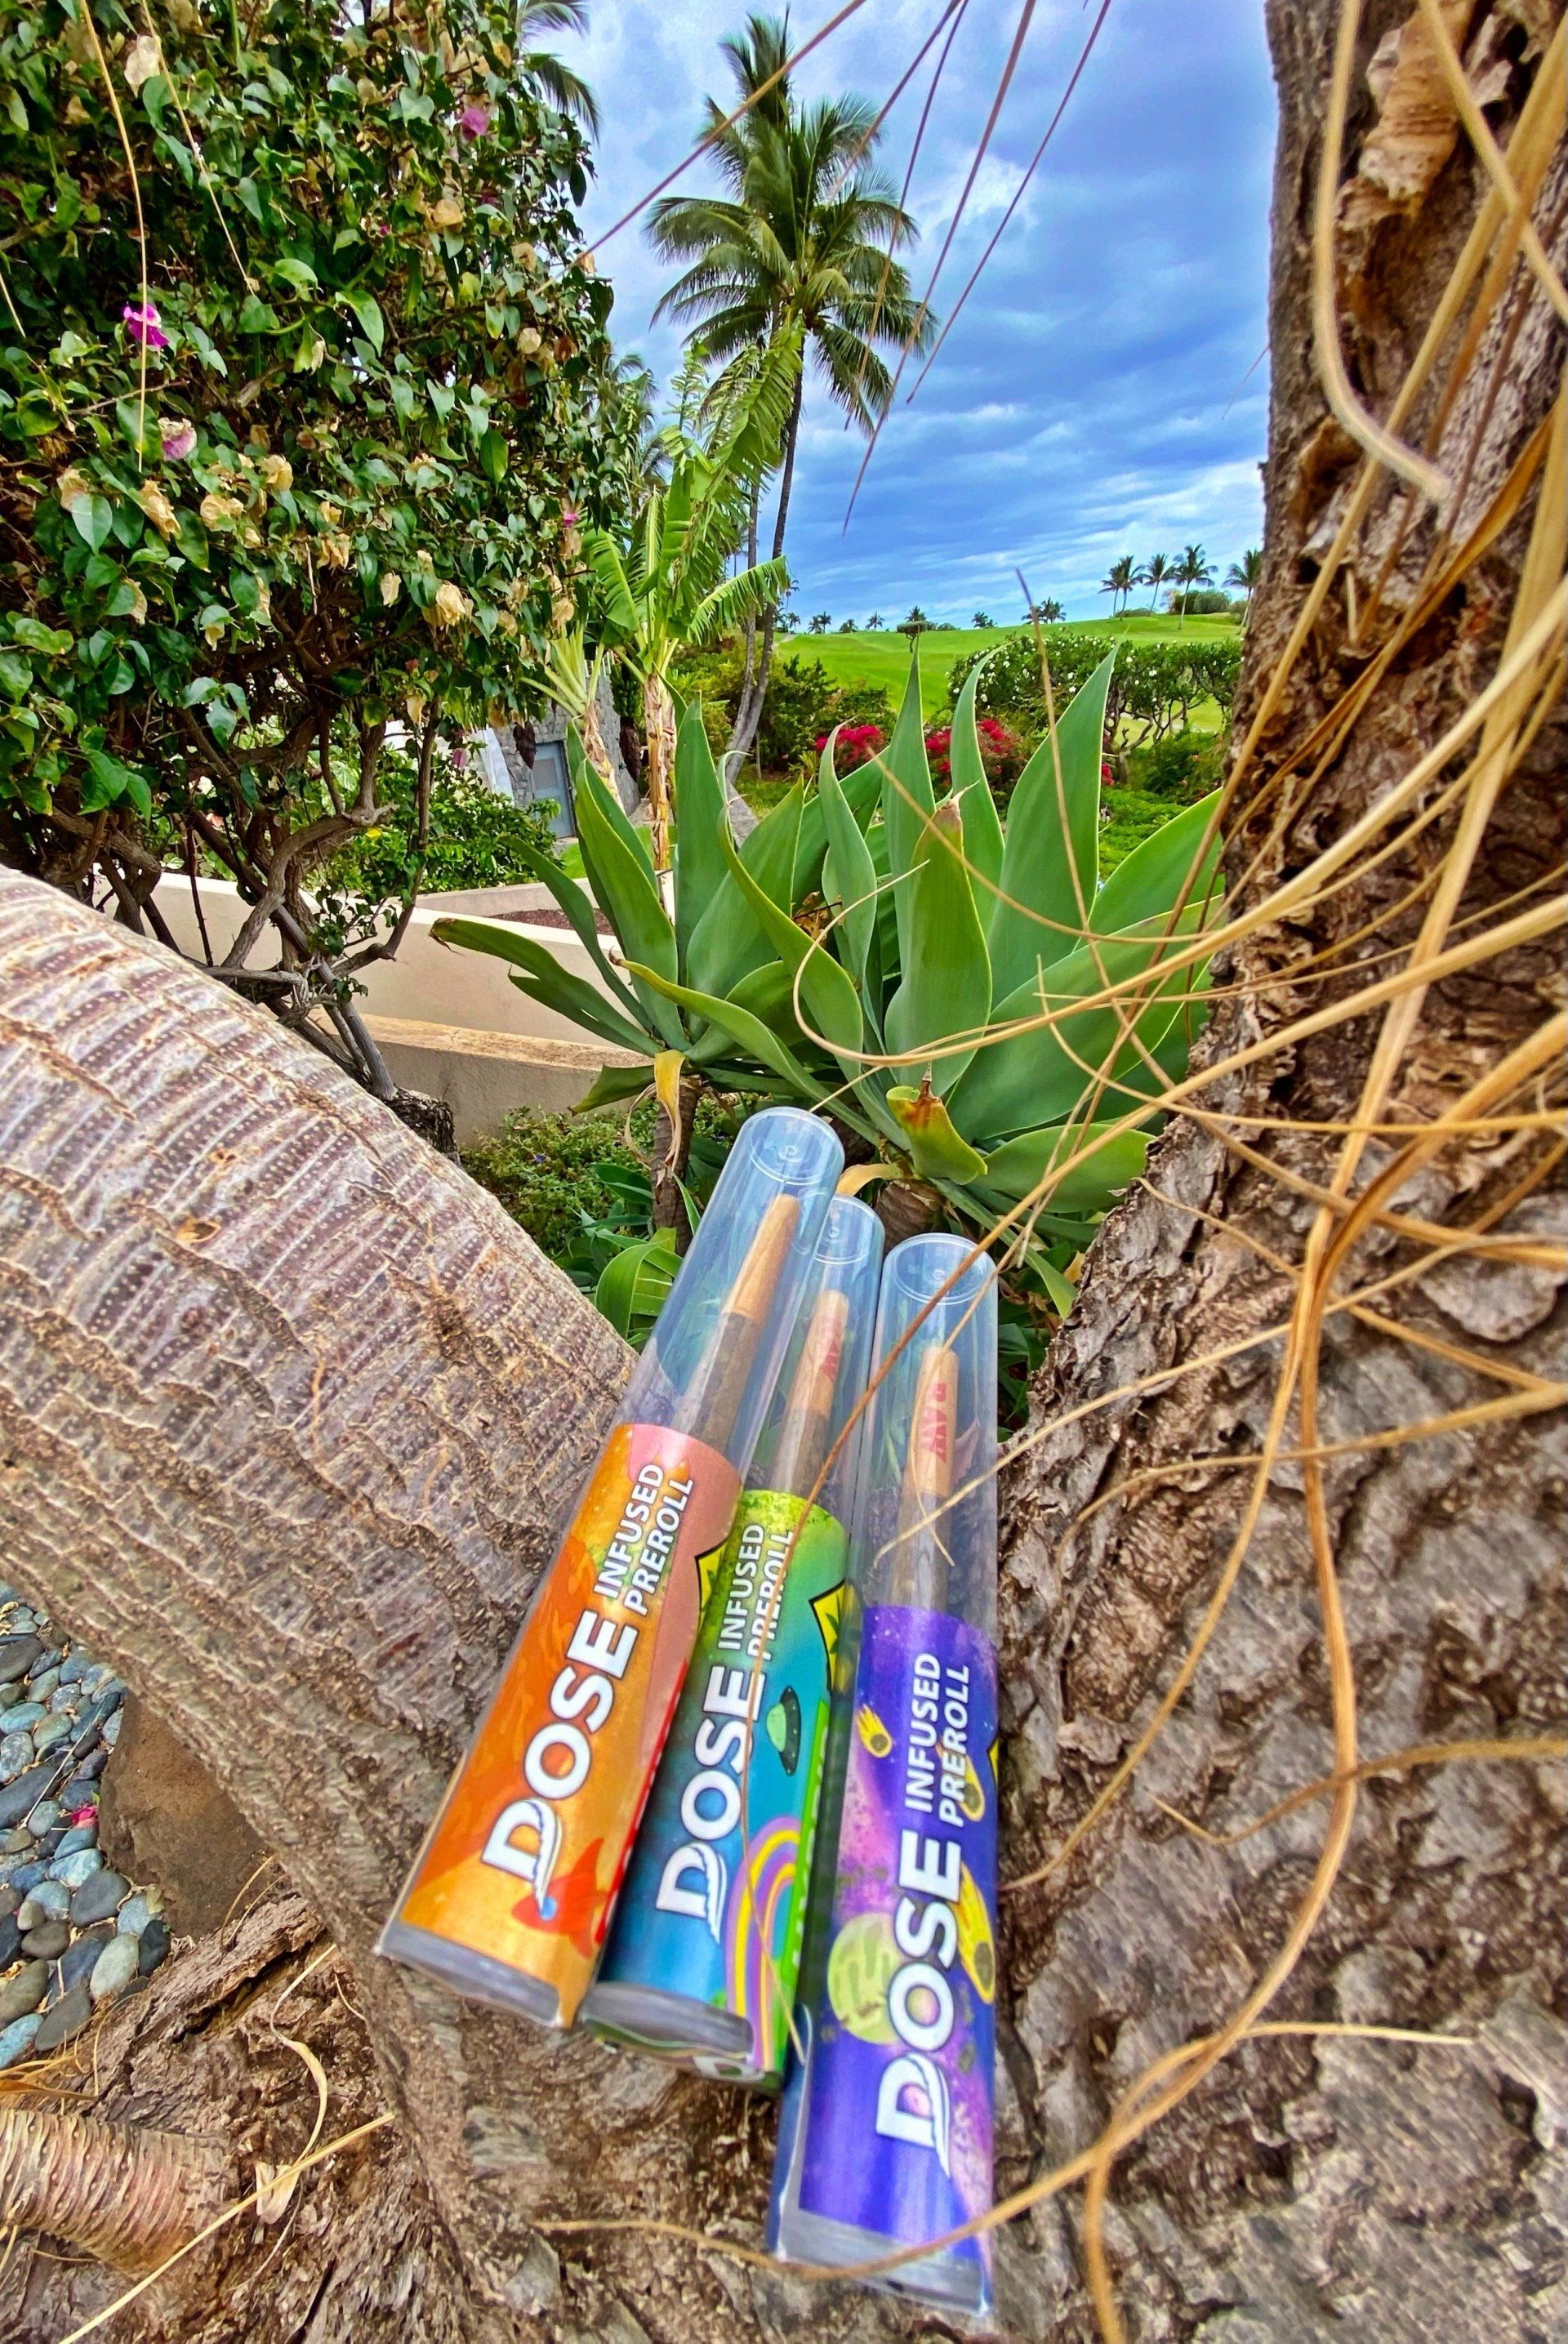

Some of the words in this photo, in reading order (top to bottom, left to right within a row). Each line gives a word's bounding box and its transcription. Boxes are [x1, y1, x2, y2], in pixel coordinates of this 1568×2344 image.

[594, 1464, 664, 1599] INFUSED
[623, 1478, 694, 1616] PREROLL
[718, 1523, 764, 1651] INFUSED
[746, 1530, 794, 1661] PREROLL
[480, 1607, 639, 1910] DOSE
[656, 1664, 766, 1945] DOSE
[904, 1651, 941, 1814] INFUSED
[938, 1664, 970, 1829] PREROLL
[875, 1829, 962, 2179] DOSE
